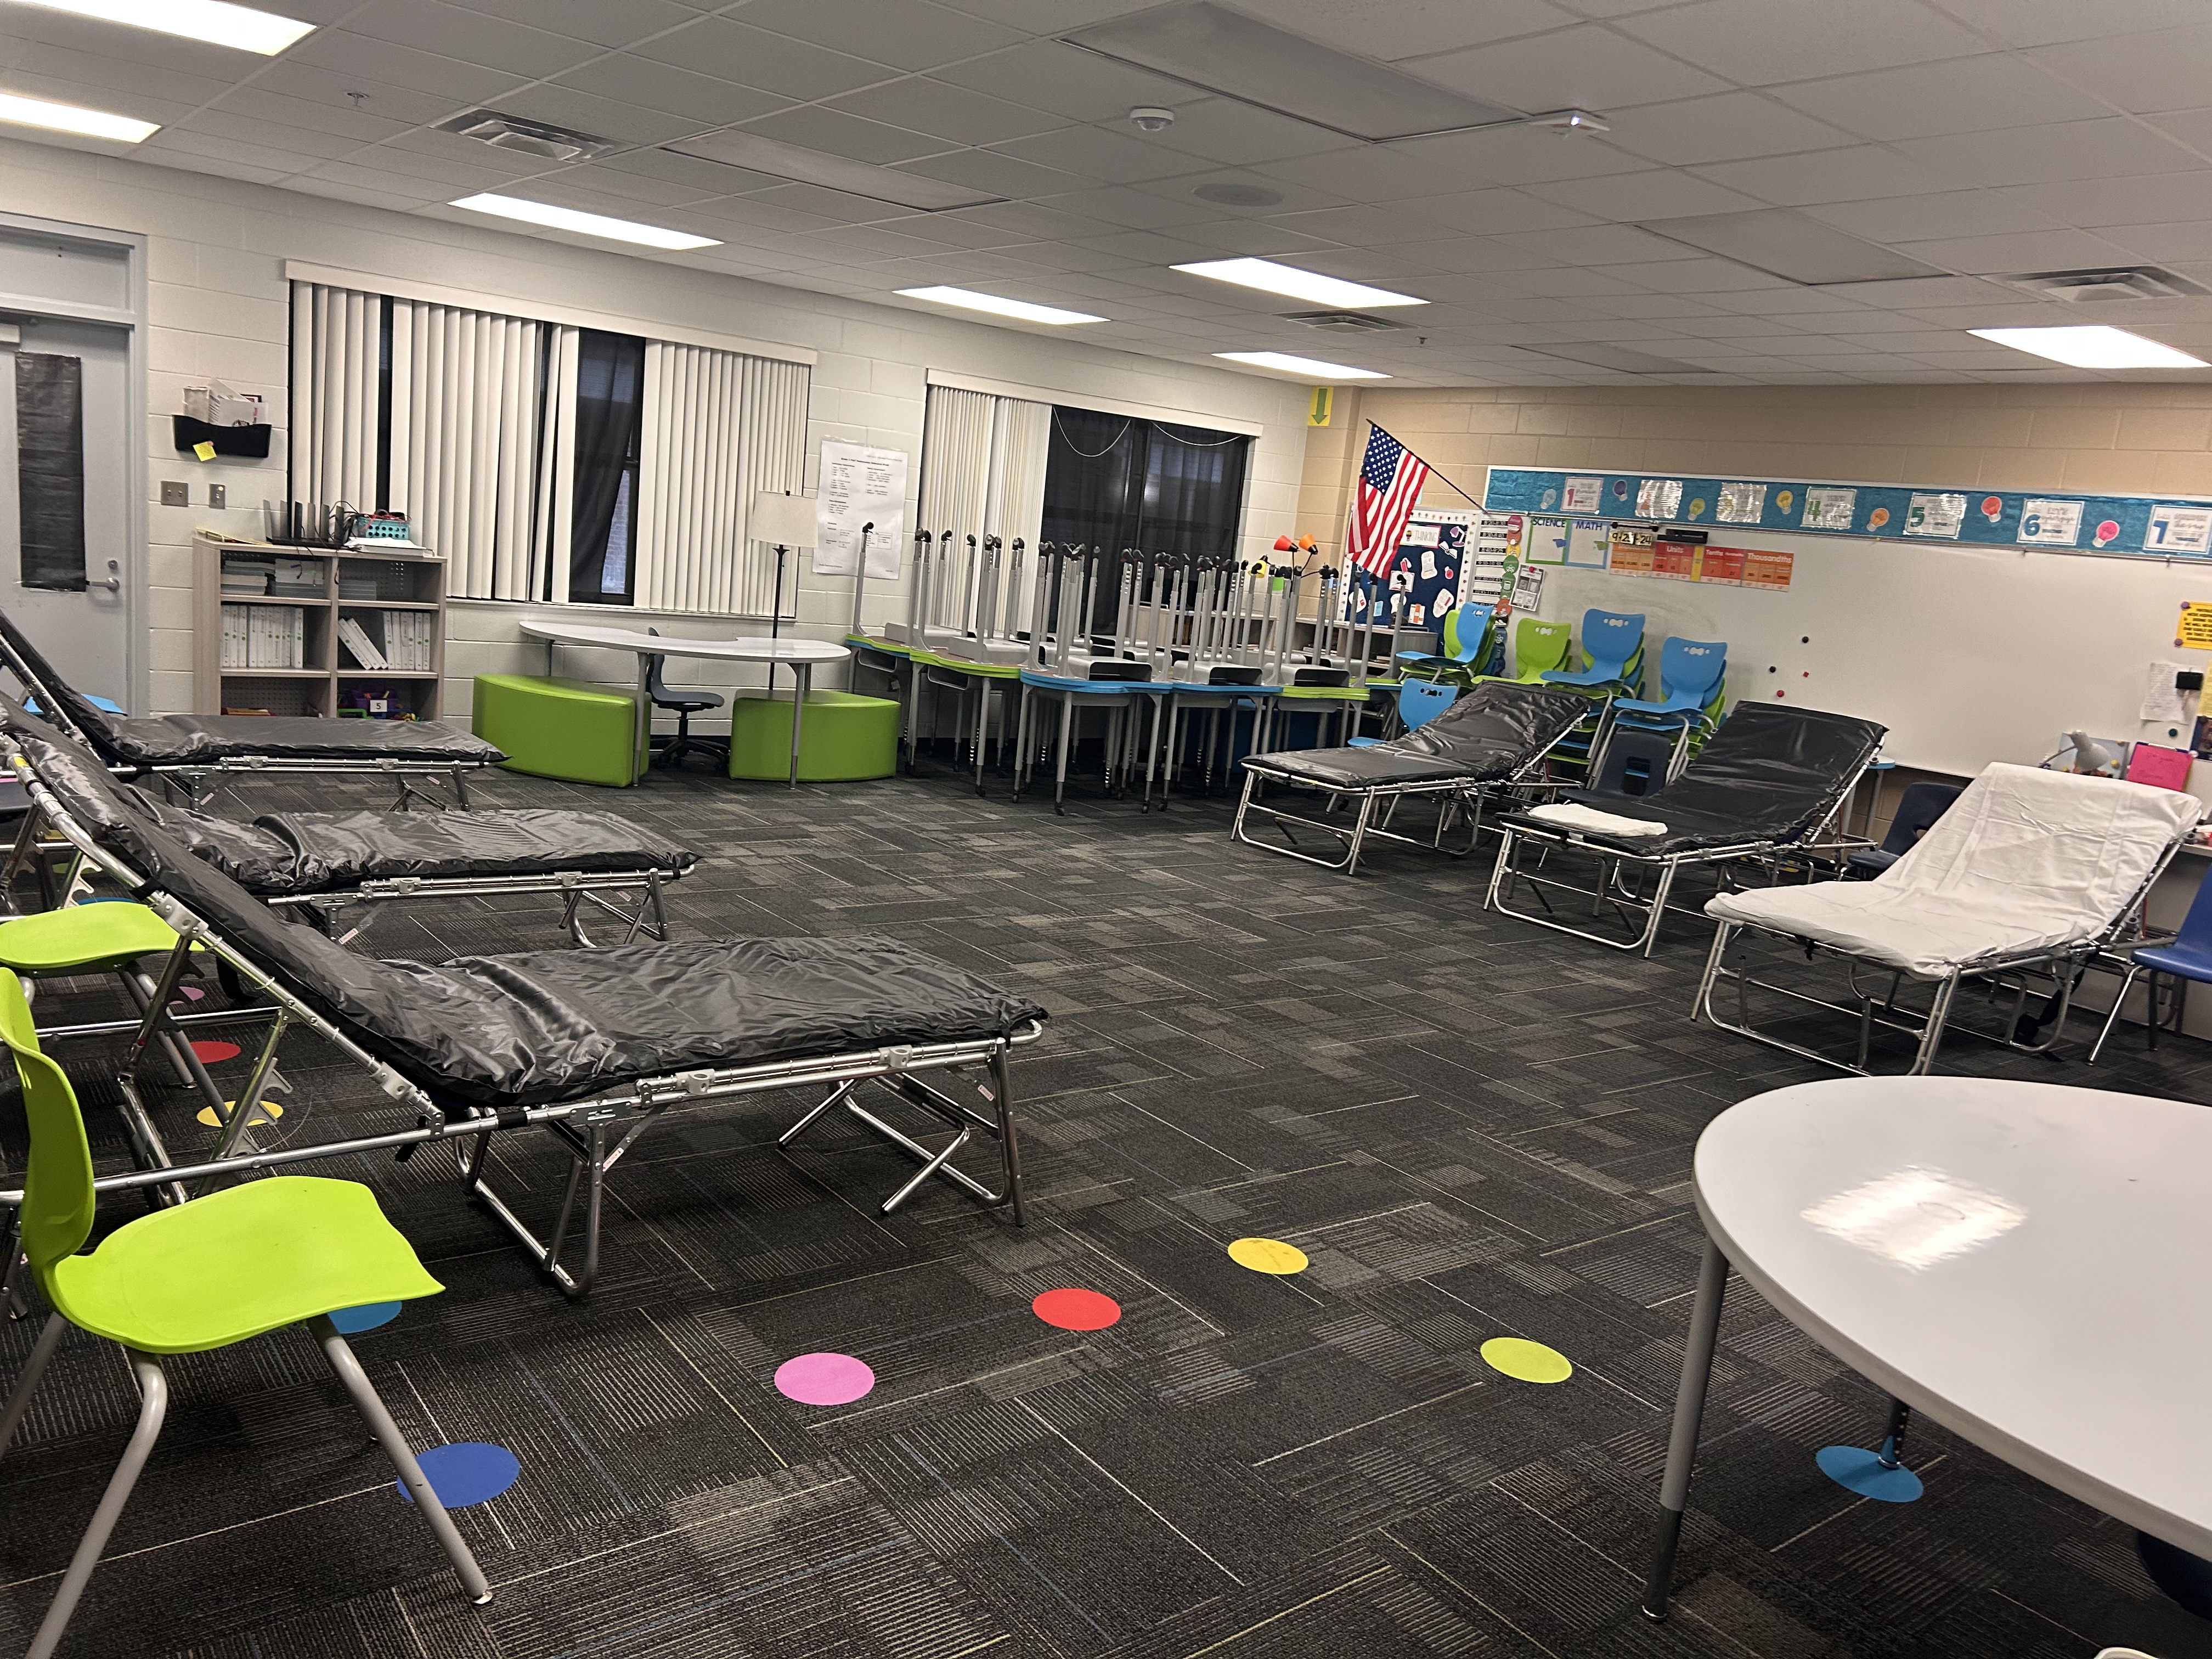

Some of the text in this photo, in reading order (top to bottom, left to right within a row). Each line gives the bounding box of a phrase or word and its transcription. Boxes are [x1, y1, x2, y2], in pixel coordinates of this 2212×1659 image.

[1567, 488, 1575, 506] 1
[1532, 517, 1566, 528] SCIENCE
[1910, 506, 1925, 527] 5
[2024, 514, 2041, 536] 6
[1575, 521, 1602, 531] MATH
[2153, 520, 2169, 544] 7
[1667, 545, 1684, 554] Units
